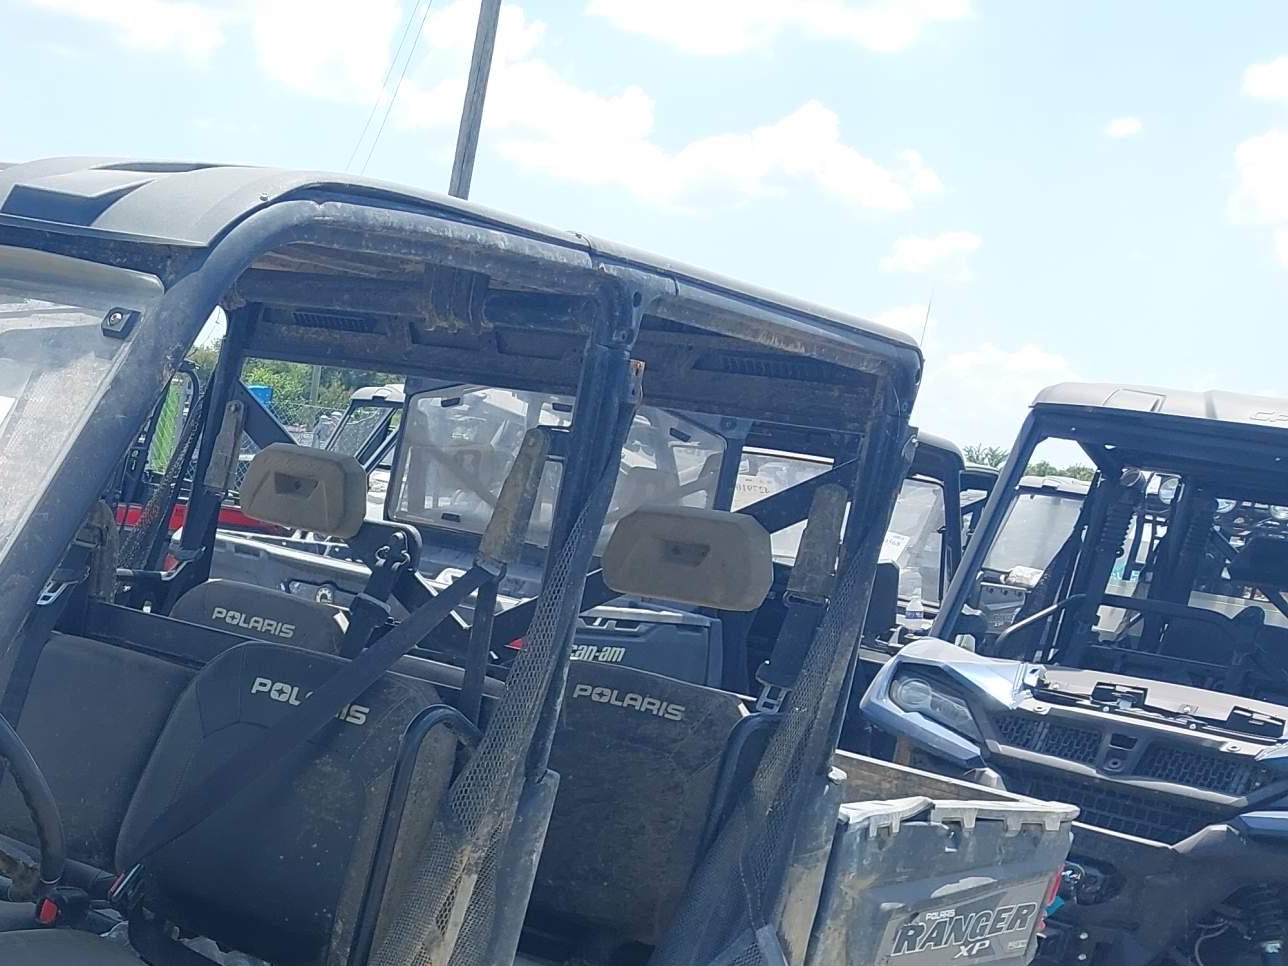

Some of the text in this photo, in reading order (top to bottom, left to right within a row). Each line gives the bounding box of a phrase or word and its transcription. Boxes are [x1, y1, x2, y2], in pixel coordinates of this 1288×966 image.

[212, 607, 296, 638] POLARIS
[251, 677, 370, 725] POLIS
[572, 684, 685, 721] POLARIS
[890, 902, 1037, 957] RANGER
[953, 939, 990, 959] XP
